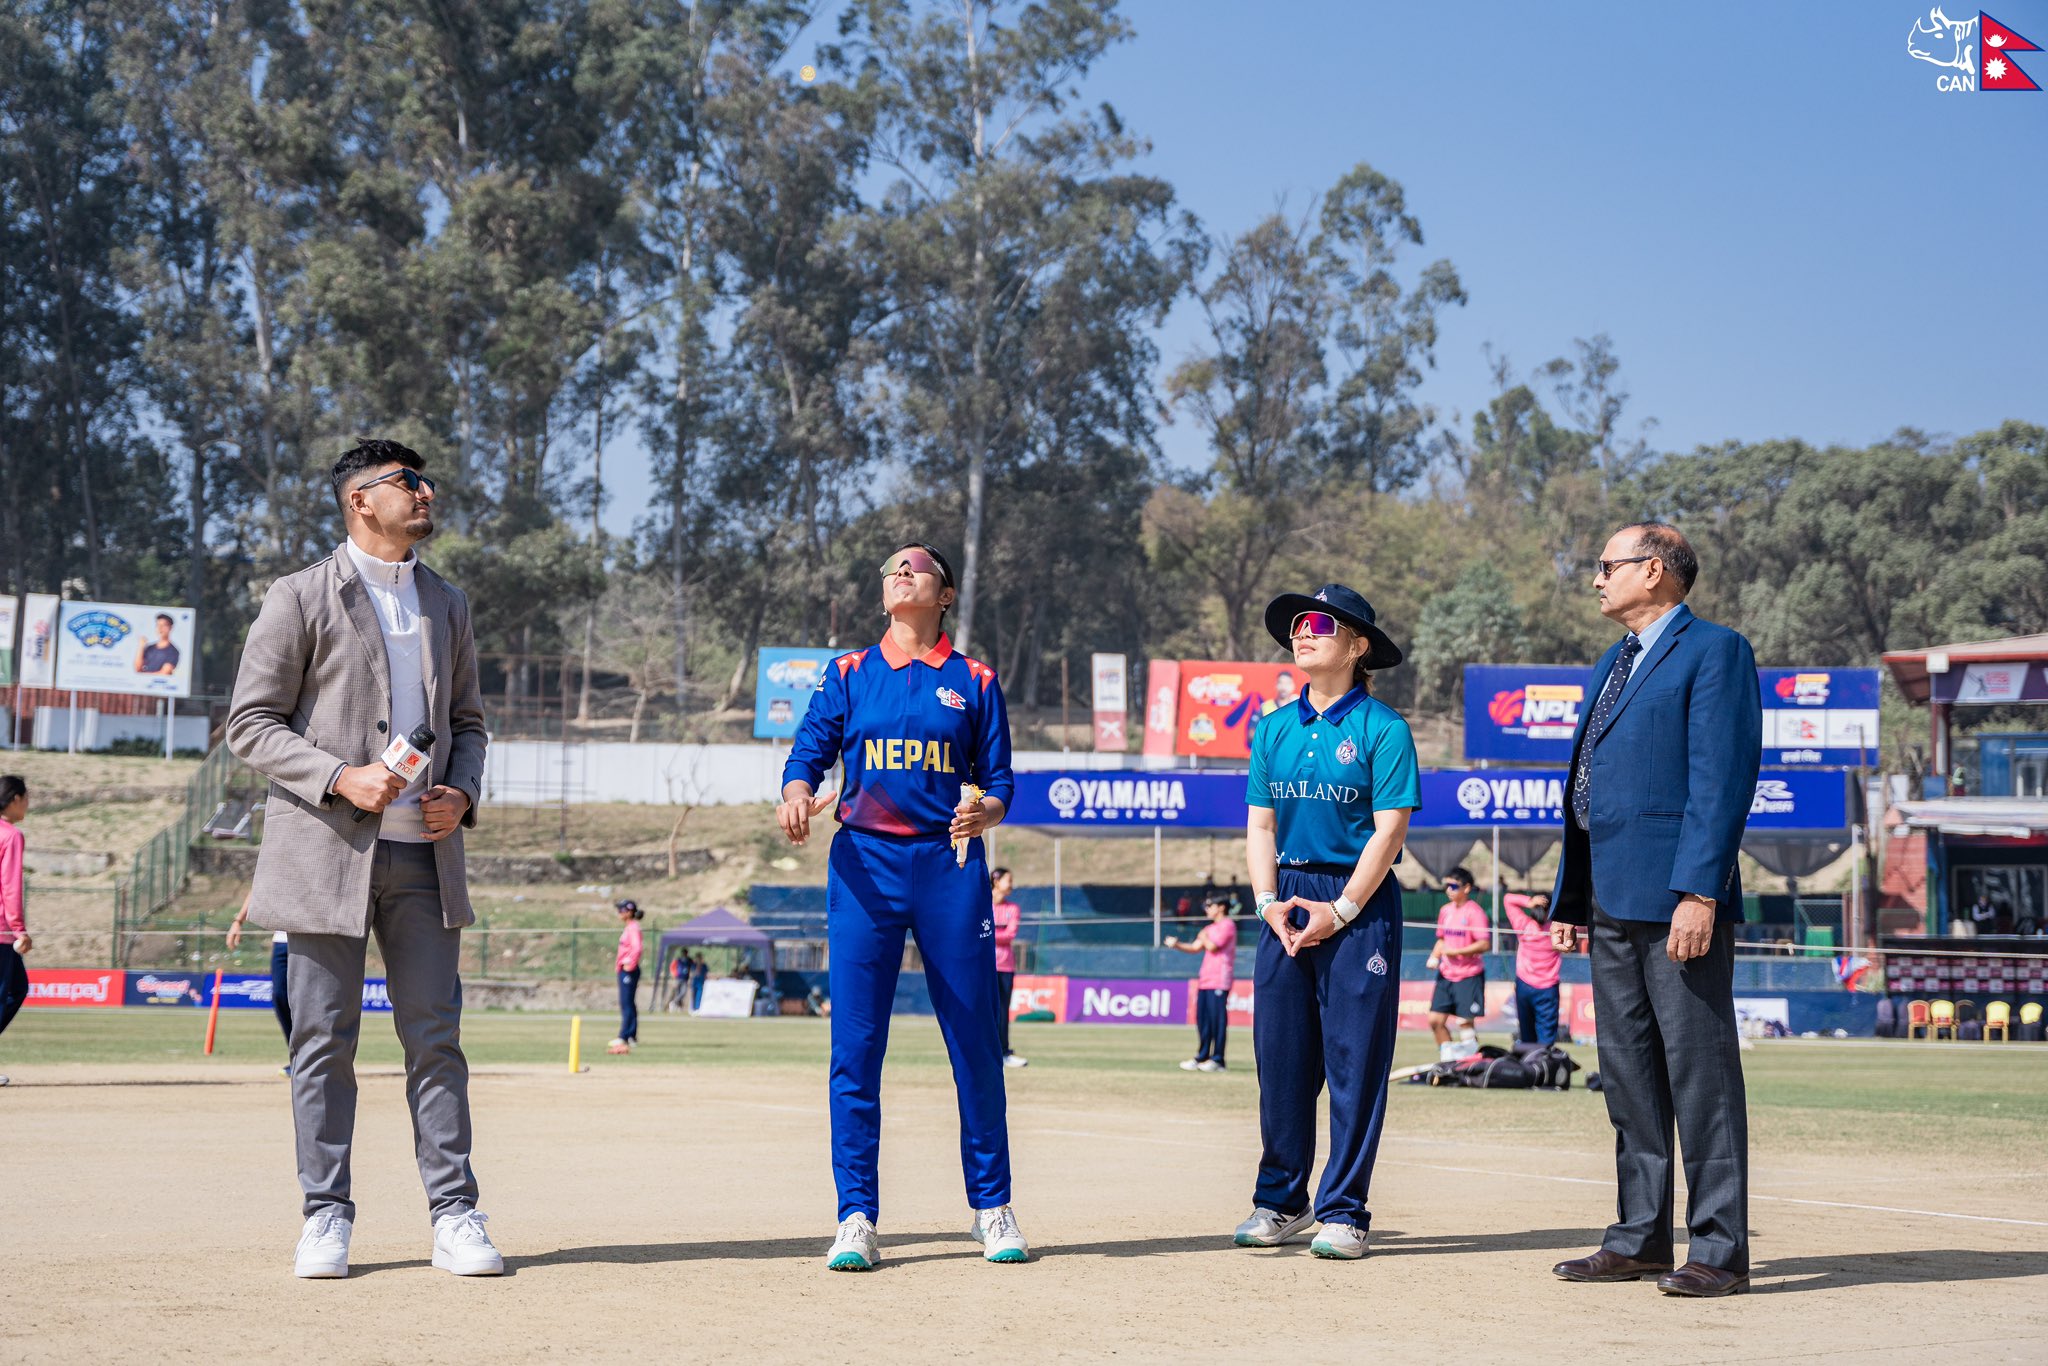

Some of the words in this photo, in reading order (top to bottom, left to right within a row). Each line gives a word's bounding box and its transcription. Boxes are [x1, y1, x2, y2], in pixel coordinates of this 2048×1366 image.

[1521, 700, 1579, 723] NPL
[864, 738, 956, 774] NEPAL
[1080, 780, 1186, 809] YAMAHA
[1269, 780, 1359, 804] THAILAND
[1489, 779, 1567, 809] YAMA
[1059, 809, 1179, 820] RACING
[1083, 987, 1171, 1018] Ncell
